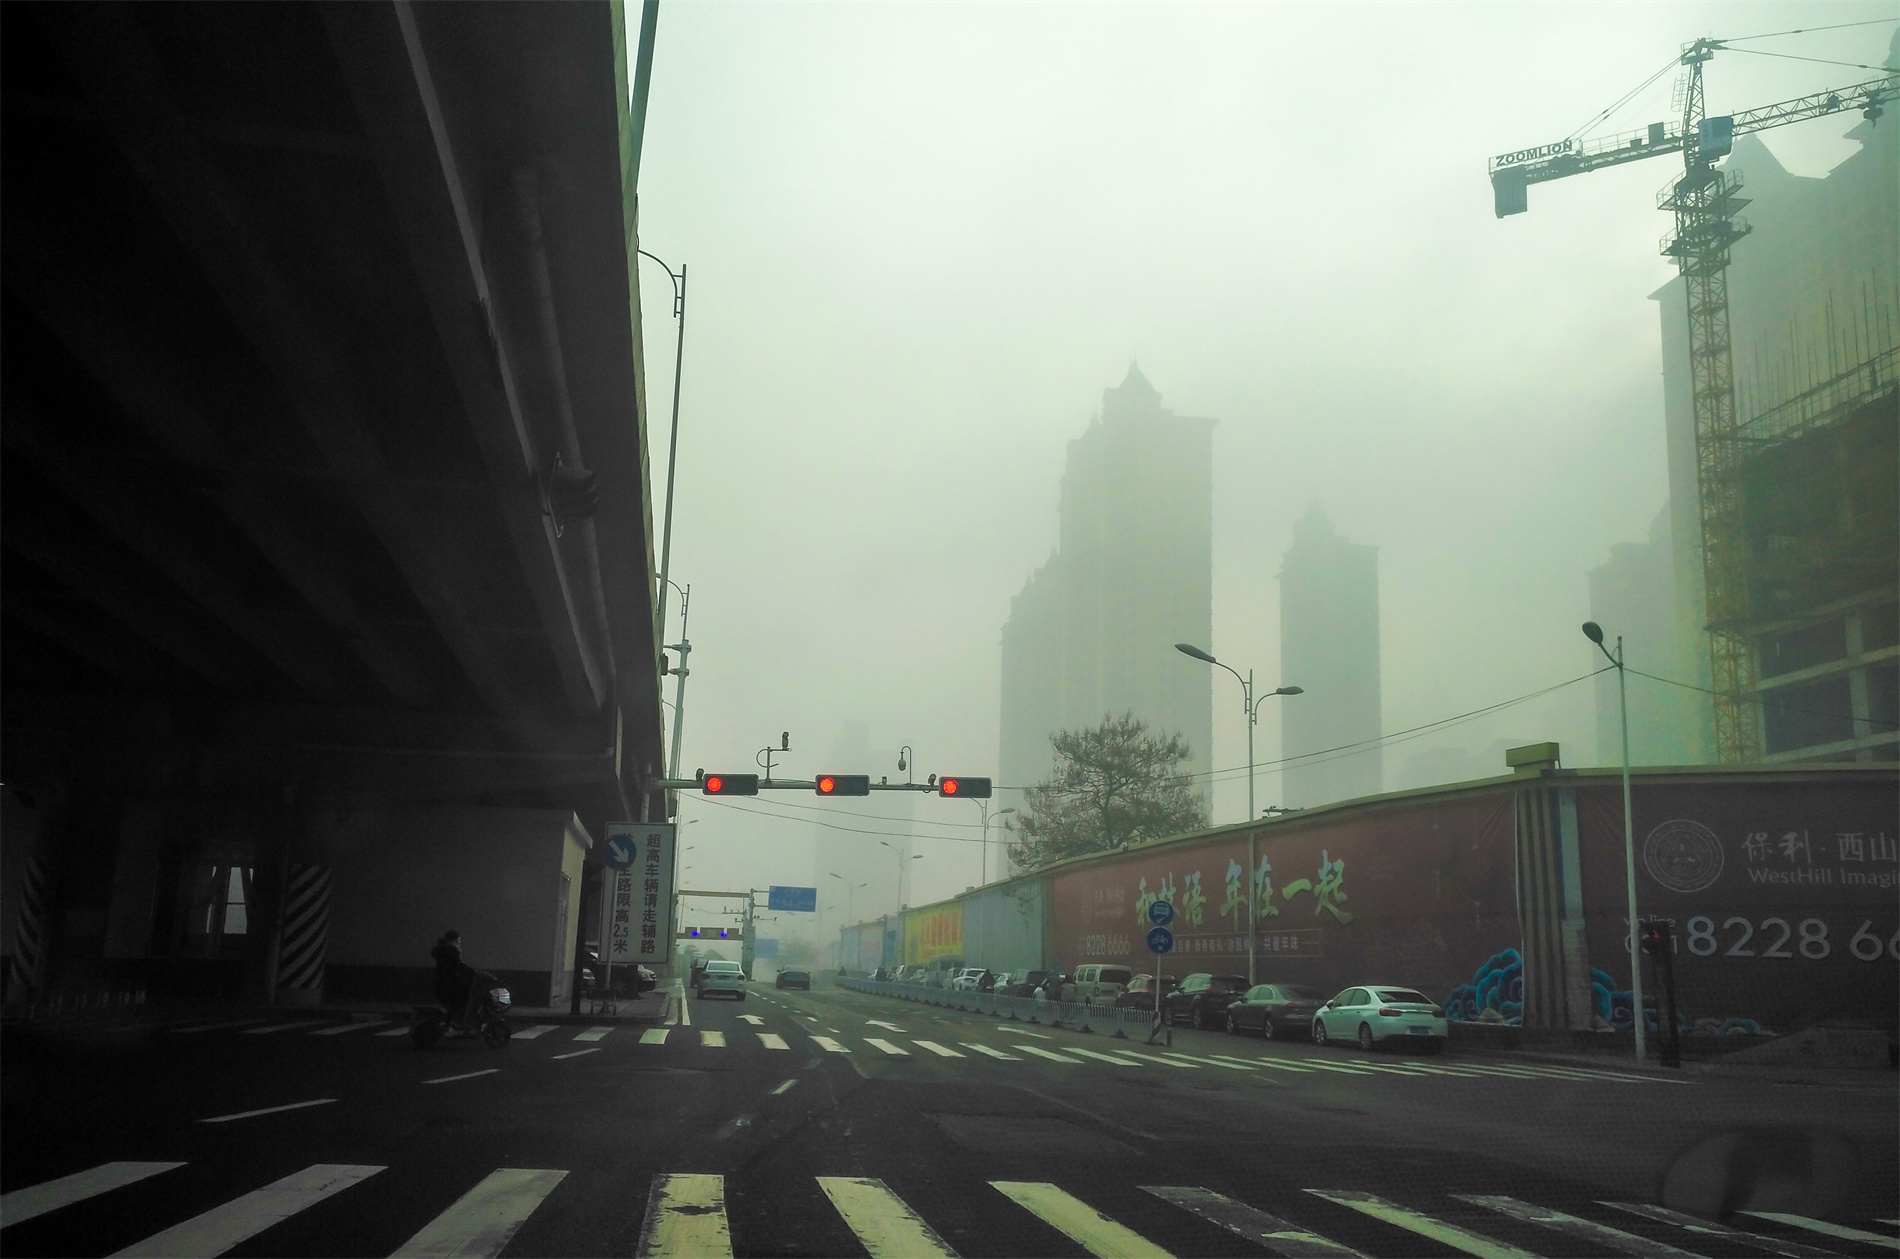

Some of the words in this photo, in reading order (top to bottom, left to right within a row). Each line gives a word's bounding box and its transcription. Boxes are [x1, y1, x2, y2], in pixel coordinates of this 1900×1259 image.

[1495, 140, 1573, 167] ZOOMLION
[1747, 867, 1833, 884] WestHill
[1839, 868, 1900, 888] Imagi
[640, 833, 661, 955] 超高车辆请走辅路
[1086, 934, 1106, 956] 8228
[1107, 932, 1131, 956] 6666
[1686, 915, 1832, 960] 8228
